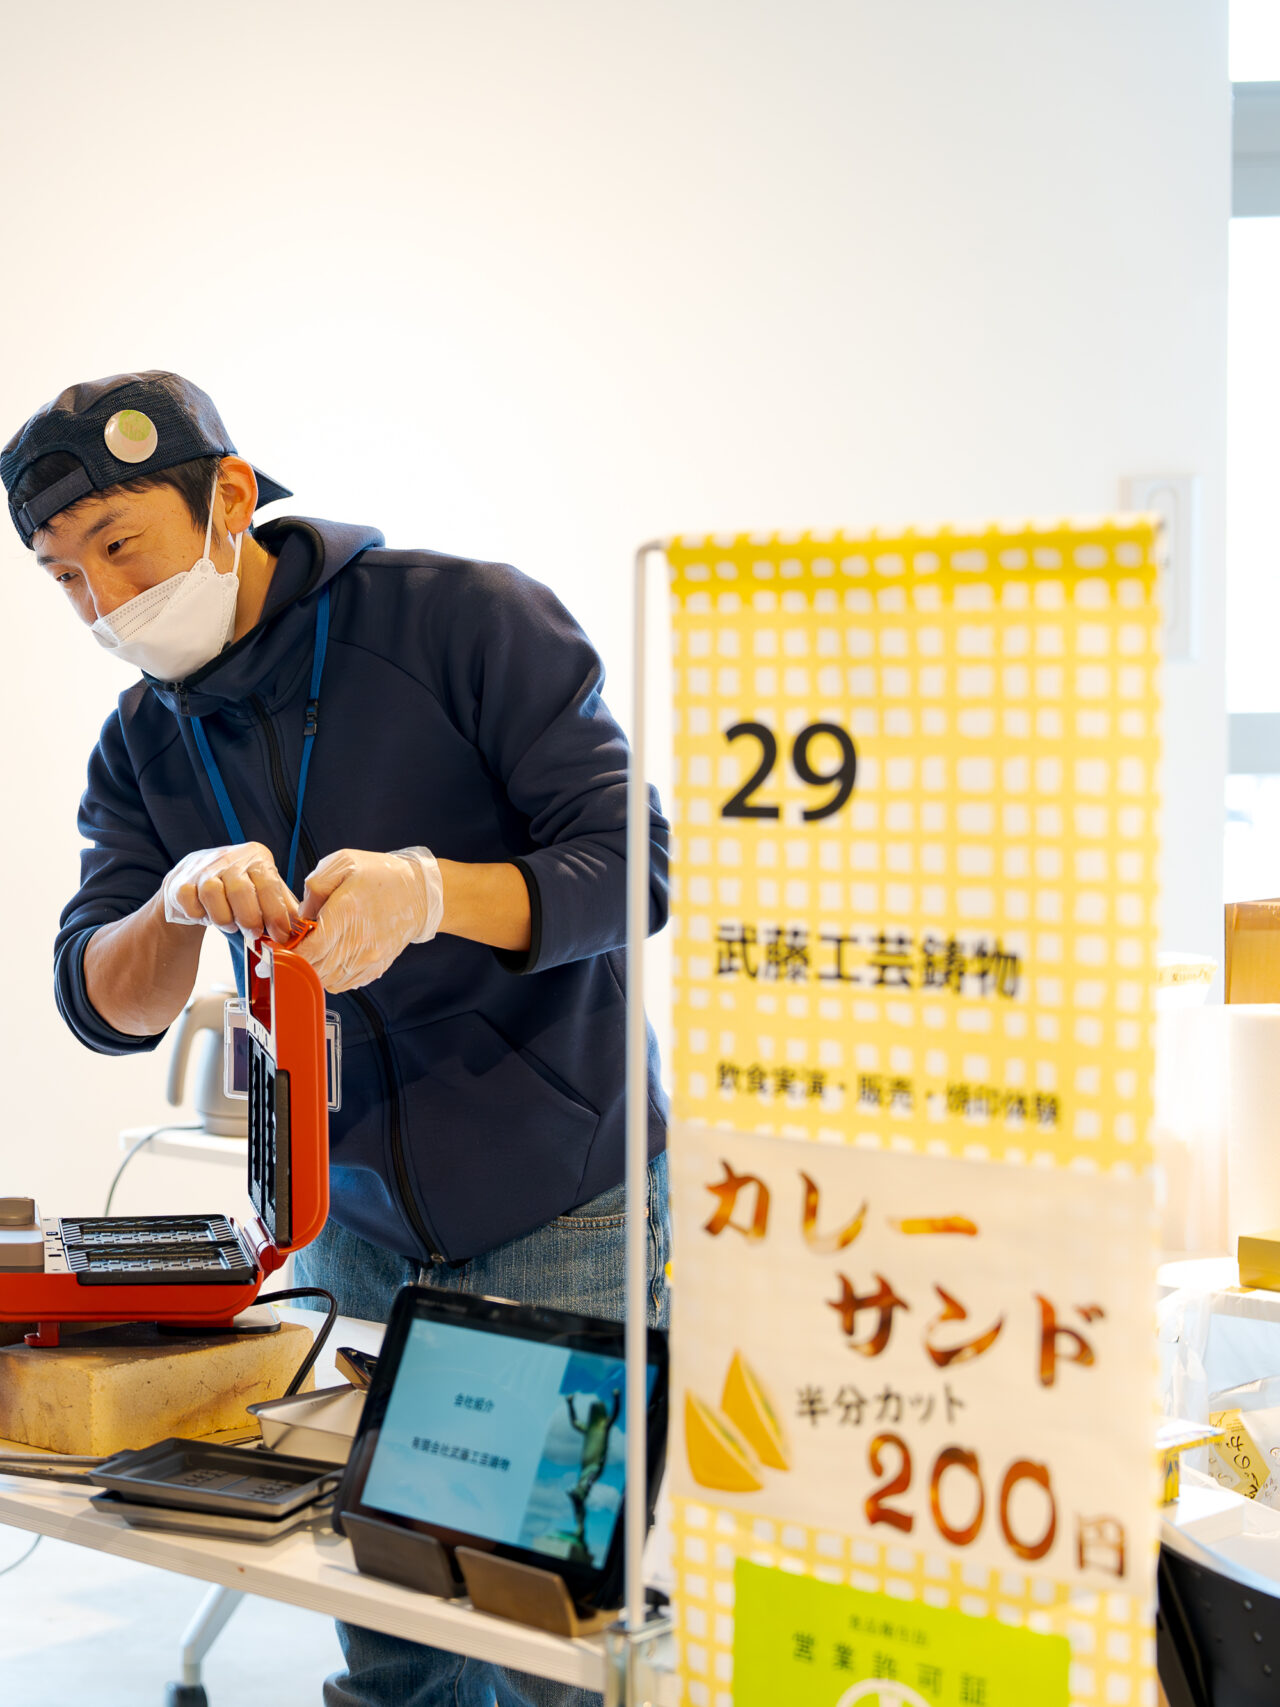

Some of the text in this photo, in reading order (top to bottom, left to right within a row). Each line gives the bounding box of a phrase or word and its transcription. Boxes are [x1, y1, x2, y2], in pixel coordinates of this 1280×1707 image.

[721, 720, 858, 822] 29
[715, 924, 1021, 998] 武藤工芸鋳物
[702, 1158, 980, 1254] カレー
[826, 1272, 1108, 1390] サンド
[795, 1384, 968, 1427] 半分カット
